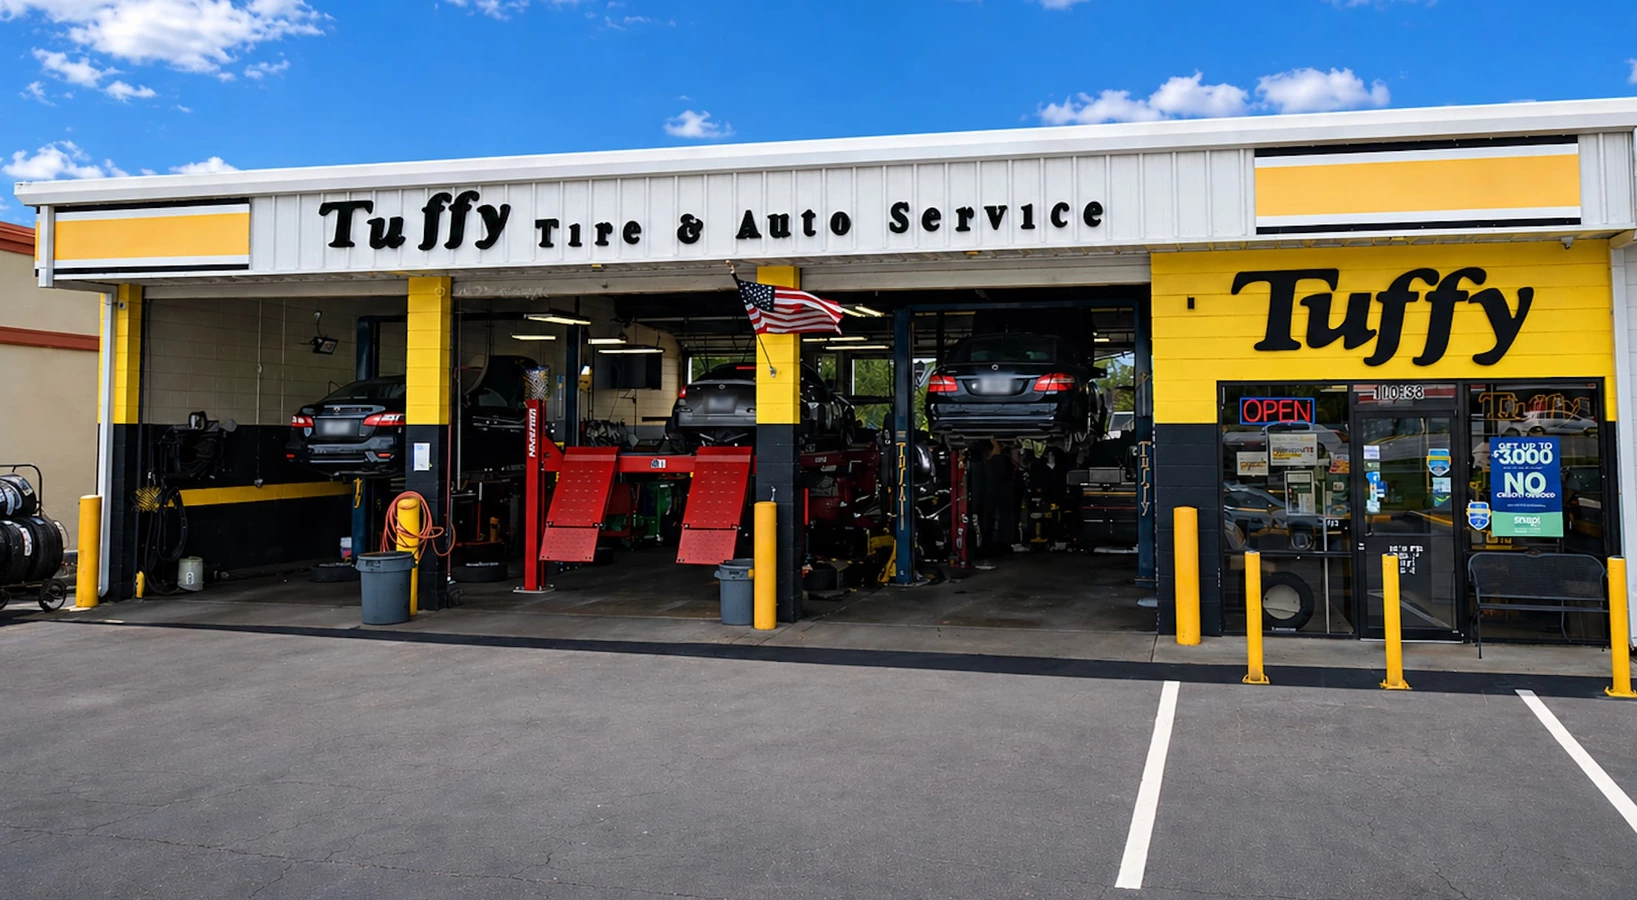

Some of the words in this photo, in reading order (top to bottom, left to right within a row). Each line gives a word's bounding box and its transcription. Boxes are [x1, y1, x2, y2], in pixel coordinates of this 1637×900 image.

[318, 190, 511, 252] Tuffy
[534, 218, 642, 249] Tire
[676, 213, 704, 245] &
[735, 209, 852, 240] Auto
[888, 201, 1104, 234] Service
[1230, 266, 1534, 367] Tuffy
[1243, 399, 1311, 423] OPEN
[1521, 442, 1536, 450] UP
[1538, 442, 1553, 450] TO
[1504, 471, 1547, 497] NO
